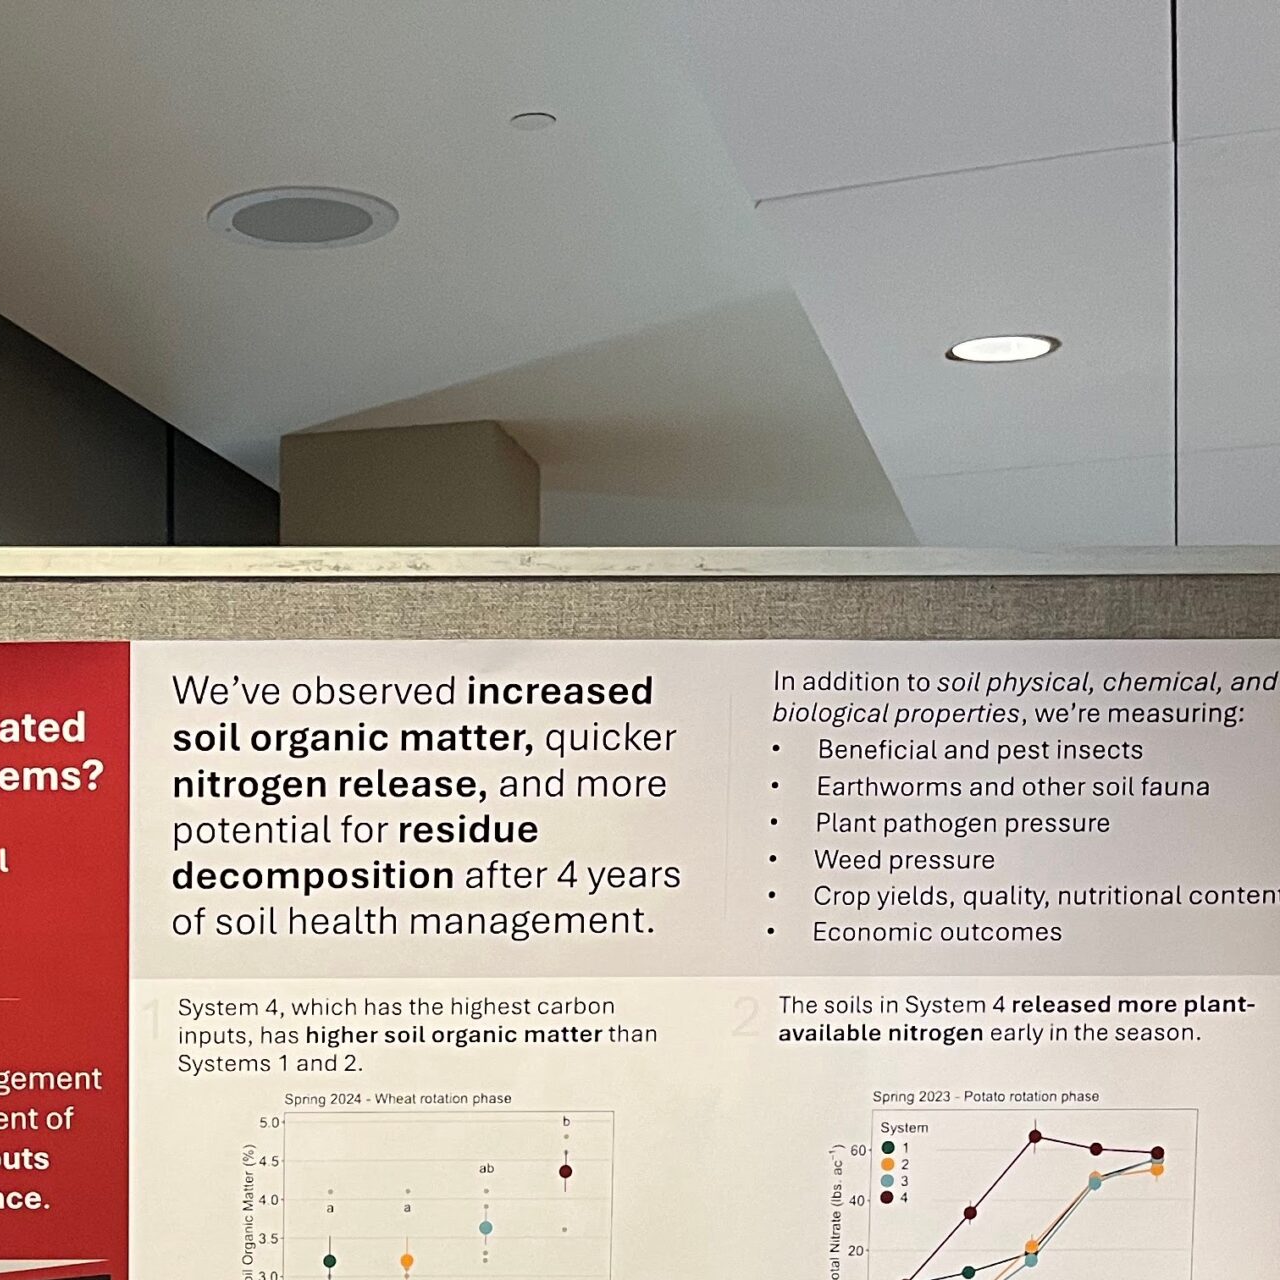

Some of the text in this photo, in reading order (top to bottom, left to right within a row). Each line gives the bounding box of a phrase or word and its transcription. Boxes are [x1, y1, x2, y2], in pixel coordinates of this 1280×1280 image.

[292, 675, 456, 706] observed
[468, 674, 653, 705] increased
[173, 721, 678, 759] soil organic matter, quicker
[819, 738, 1143, 765] Beneficial and pest insects
[174, 767, 667, 806] nitrogen release, and more
[174, 813, 538, 852] potential for residue
[816, 812, 1110, 838] Plant pathogen pressure
[814, 849, 995, 875] Weed pressure
[172, 859, 681, 897] decomposition after 4 years
[172, 905, 654, 942] of soil health management.
[813, 921, 1063, 942] Economic outcomes
[872, 1090, 915, 1106] Spring
[918, 1090, 951, 1103] 2023
[964, 1090, 1006, 1103] Potato
[1009, 1091, 1058, 1103] rotation
[1061, 1090, 1100, 1105] phase
[46, 1105, 75, 1130] of
[259, 1116, 280, 1129] 5.0
[880, 1121, 929, 1136] System
[258, 1155, 280, 1168] 4.5
[258, 1193, 279, 1206] 4.0
[258, 1232, 279, 1245] 3.5
